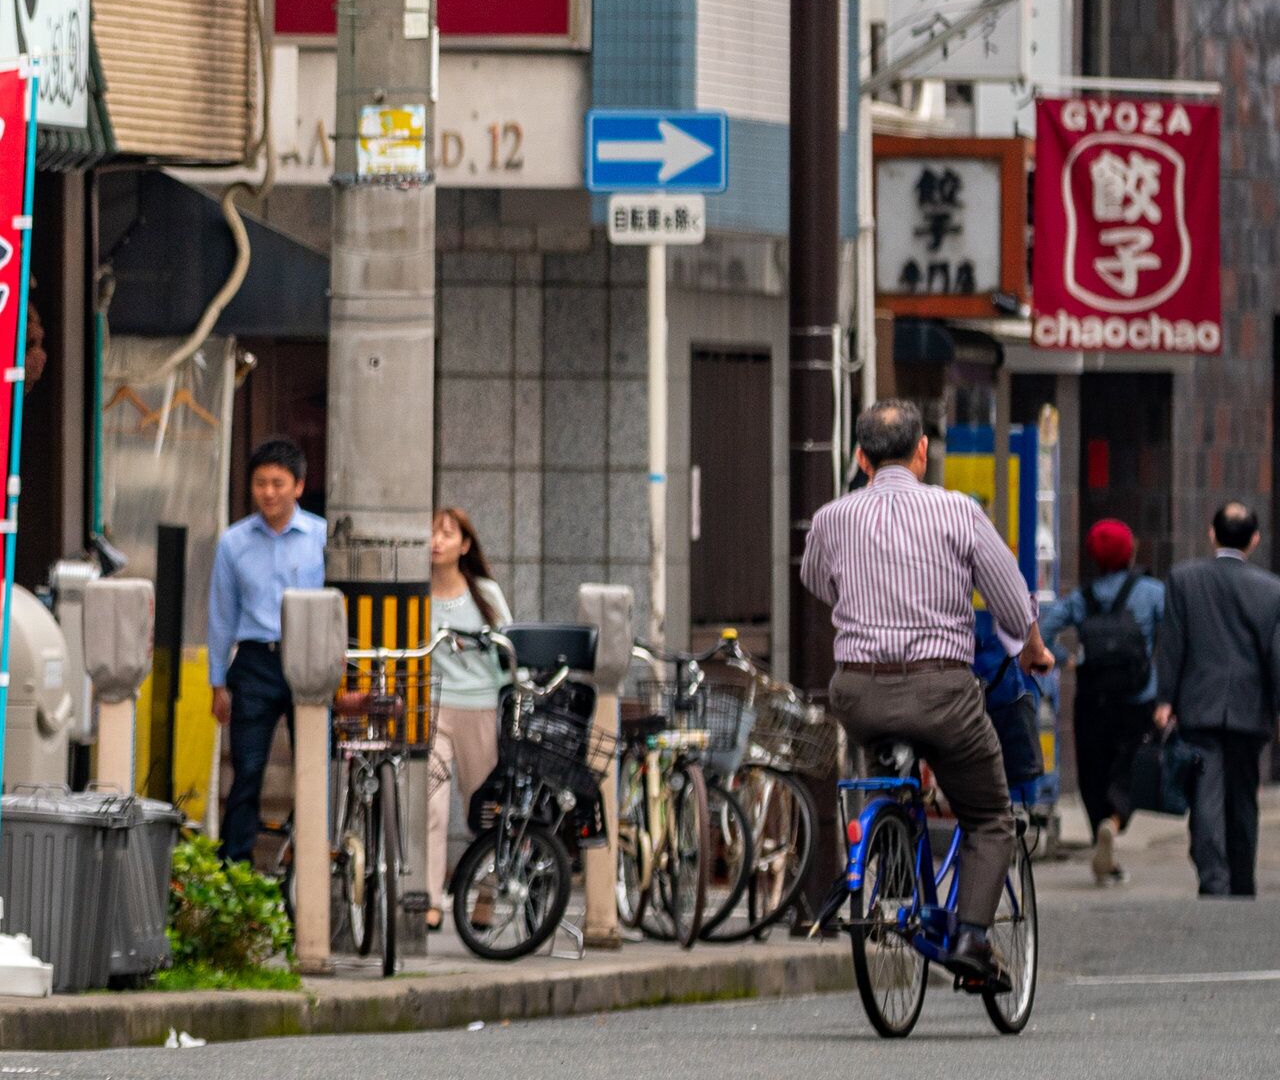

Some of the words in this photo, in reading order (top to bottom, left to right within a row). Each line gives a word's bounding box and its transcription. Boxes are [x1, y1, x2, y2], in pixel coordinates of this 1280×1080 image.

[1061, 99, 1192, 136] GYOZA
[1090, 150, 1162, 296] 餃子
[1034, 311, 1221, 350] chaochao
